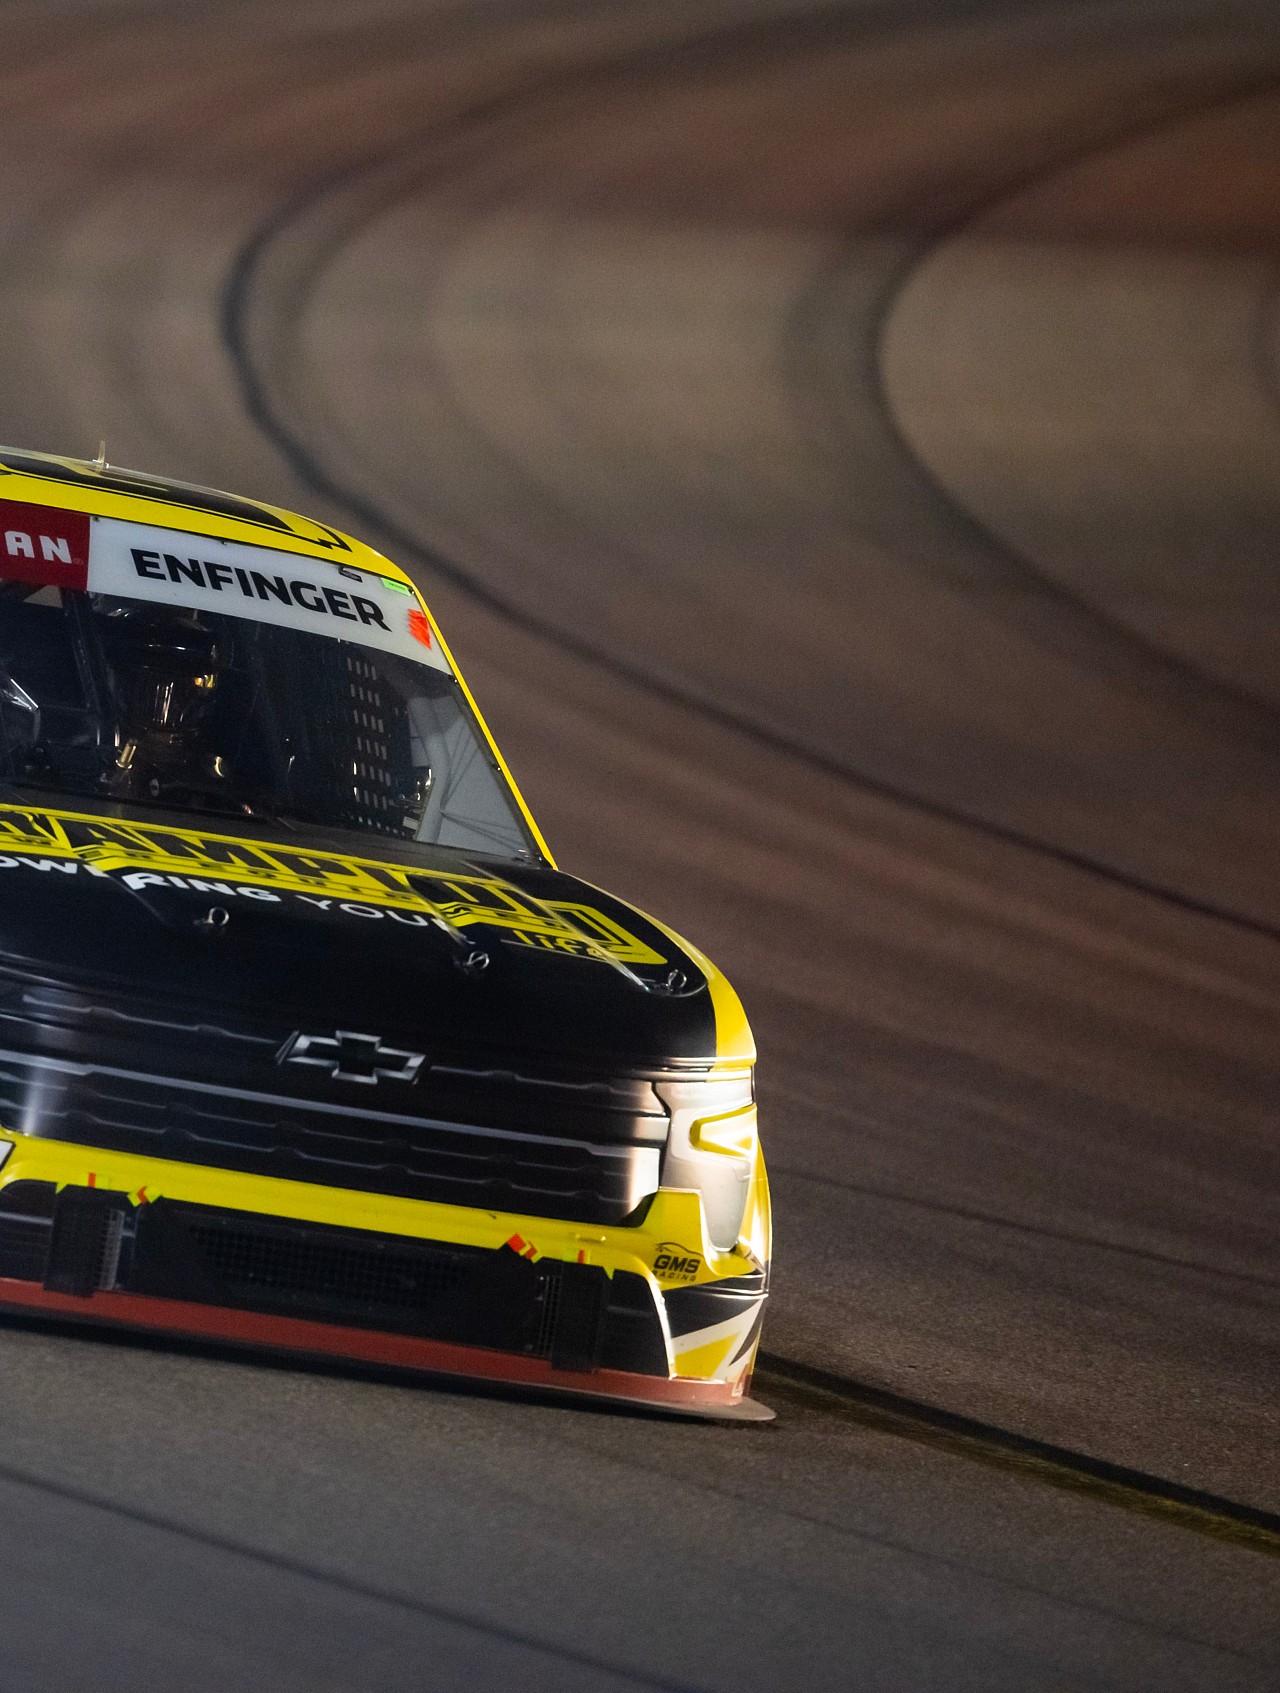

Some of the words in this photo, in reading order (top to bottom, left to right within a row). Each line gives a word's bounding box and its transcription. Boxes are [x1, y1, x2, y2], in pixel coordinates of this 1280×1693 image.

[130, 548, 392, 632] ENFINGER
[652, 1254, 701, 1275] GMS
[652, 1270, 697, 1282] RACING
